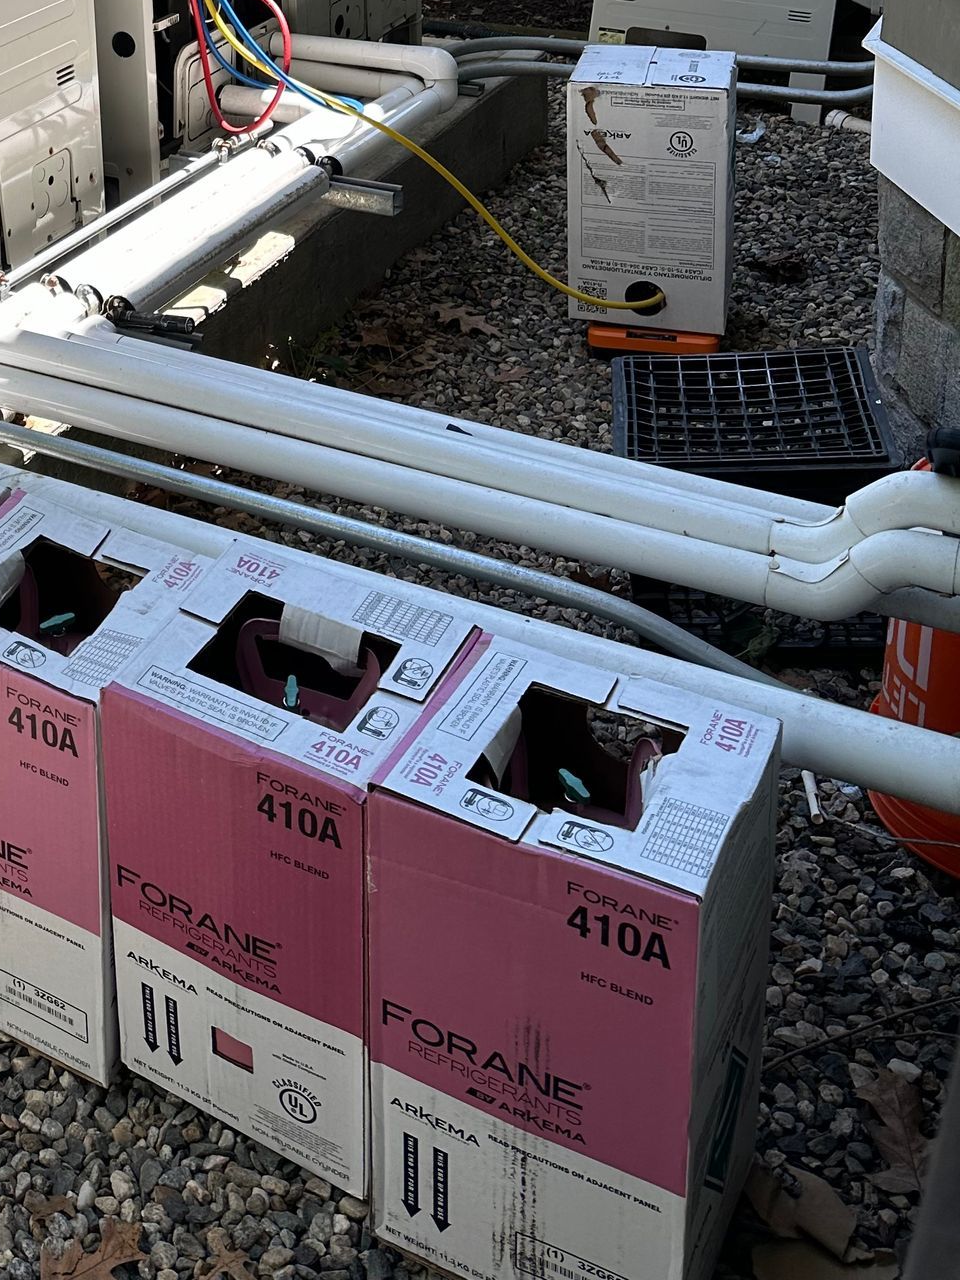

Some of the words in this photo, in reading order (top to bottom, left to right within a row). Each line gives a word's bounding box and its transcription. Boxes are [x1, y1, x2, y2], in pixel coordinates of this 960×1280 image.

[654, 272, 712, 282] DIFLUOROMETANO
[163, 560, 196, 589] 410A
[236, 556, 281, 580] 410A
[176, 691, 208, 708] PLASTIC
[207, 704, 226, 716] SEAL
[228, 712, 236, 720] IS
[240, 710, 270, 724] INVALID
[8, 706, 79, 758] 410A
[714, 718, 748, 752] 410A
[310, 740, 362, 770] 410A
[410, 752, 448, 787] 410A
[20, 760, 38, 773] HFC
[40, 768, 69, 786] BLEND
[257, 794, 342, 850] 410A
[270, 850, 291, 864] HFC
[294, 860, 330, 880] BLEND
[24, 916, 33, 925] ON
[34, 922, 65, 940] ADJACENT
[66, 938, 86, 950] PANEL
[140, 900, 276, 978] REFRIGERANTS
[566, 904, 672, 970] 410A
[126, 950, 198, 996] ARKEMA
[210, 954, 282, 994] ARKEMA
[580, 971, 607, 988] HFC
[610, 982, 654, 1006] BLEND
[12, 978, 26, 991] (1)
[34, 988, 66, 1010] 3ZG62
[206, 986, 222, 1000] READ
[224, 996, 272, 1024] PRECAUTIONS
[272, 1019, 283, 1030] ON
[284, 1024, 321, 1046] ADJACENT
[322, 1042, 346, 1056] PANEL
[134, 1058, 147, 1068] NET
[190, 1090, 202, 1100] KG
[272, 1078, 322, 1108] CLASSIFIED
[408, 1040, 582, 1126] REFRIGERANTS
[288, 1094, 308, 1118] UL
[390, 1097, 480, 1148] ARKEMA
[498, 1101, 587, 1146] ARKEMA
[252, 1124, 311, 1161] NON-REUSABLE
[312, 1157, 350, 1181] CYLINDER
[488, 1134, 510, 1148] READ
[510, 1144, 570, 1174] PRECAUTIONS
[571, 1170, 584, 1181] ON
[586, 1176, 632, 1200] ADJACENT
[633, 1196, 662, 1214] PANEL
[385, 1225, 402, 1238] NET
[403, 1234, 437, 1256] WEIGHT:
[457, 1262, 470, 1273] KG
[546, 1248, 564, 1262] (1)
